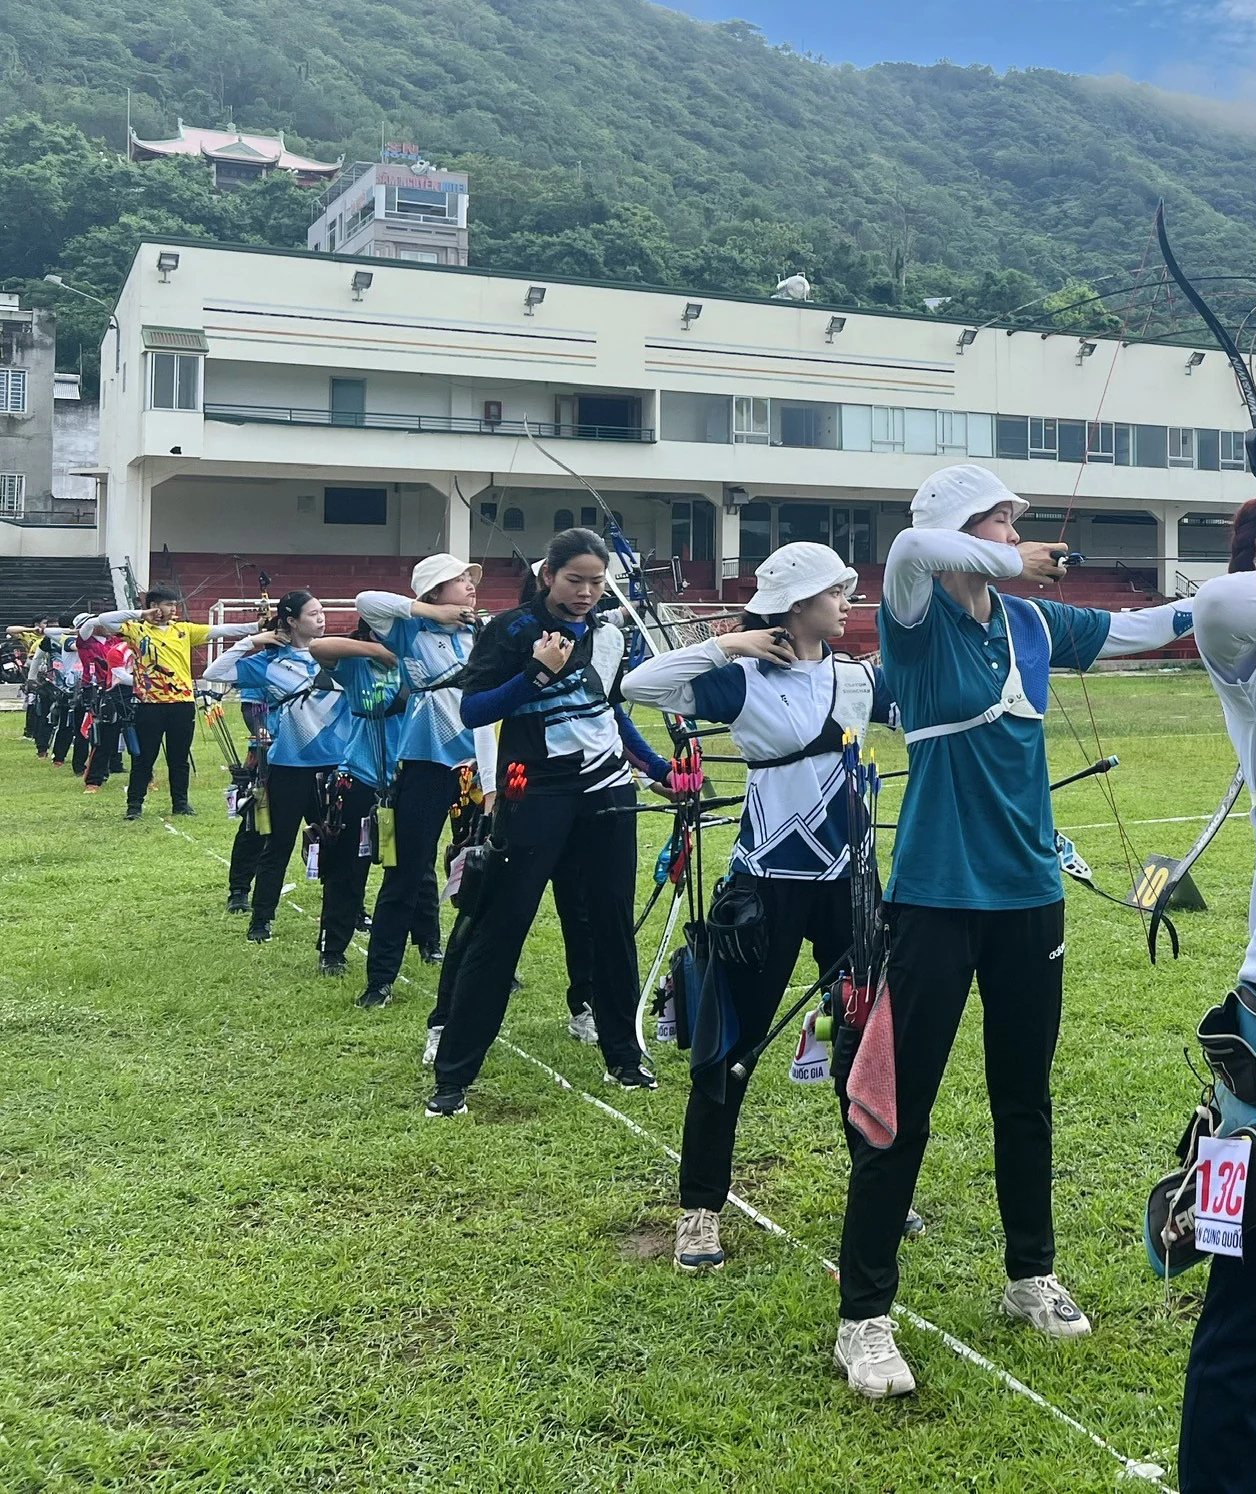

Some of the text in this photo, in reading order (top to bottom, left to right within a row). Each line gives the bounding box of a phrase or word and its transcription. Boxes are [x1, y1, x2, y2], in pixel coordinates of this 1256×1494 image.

[386, 142, 419, 155] SN
[1132, 864, 1169, 907] 10
[810, 1066, 824, 1079] GIA
[1203, 1228, 1221, 1245] CUNG
